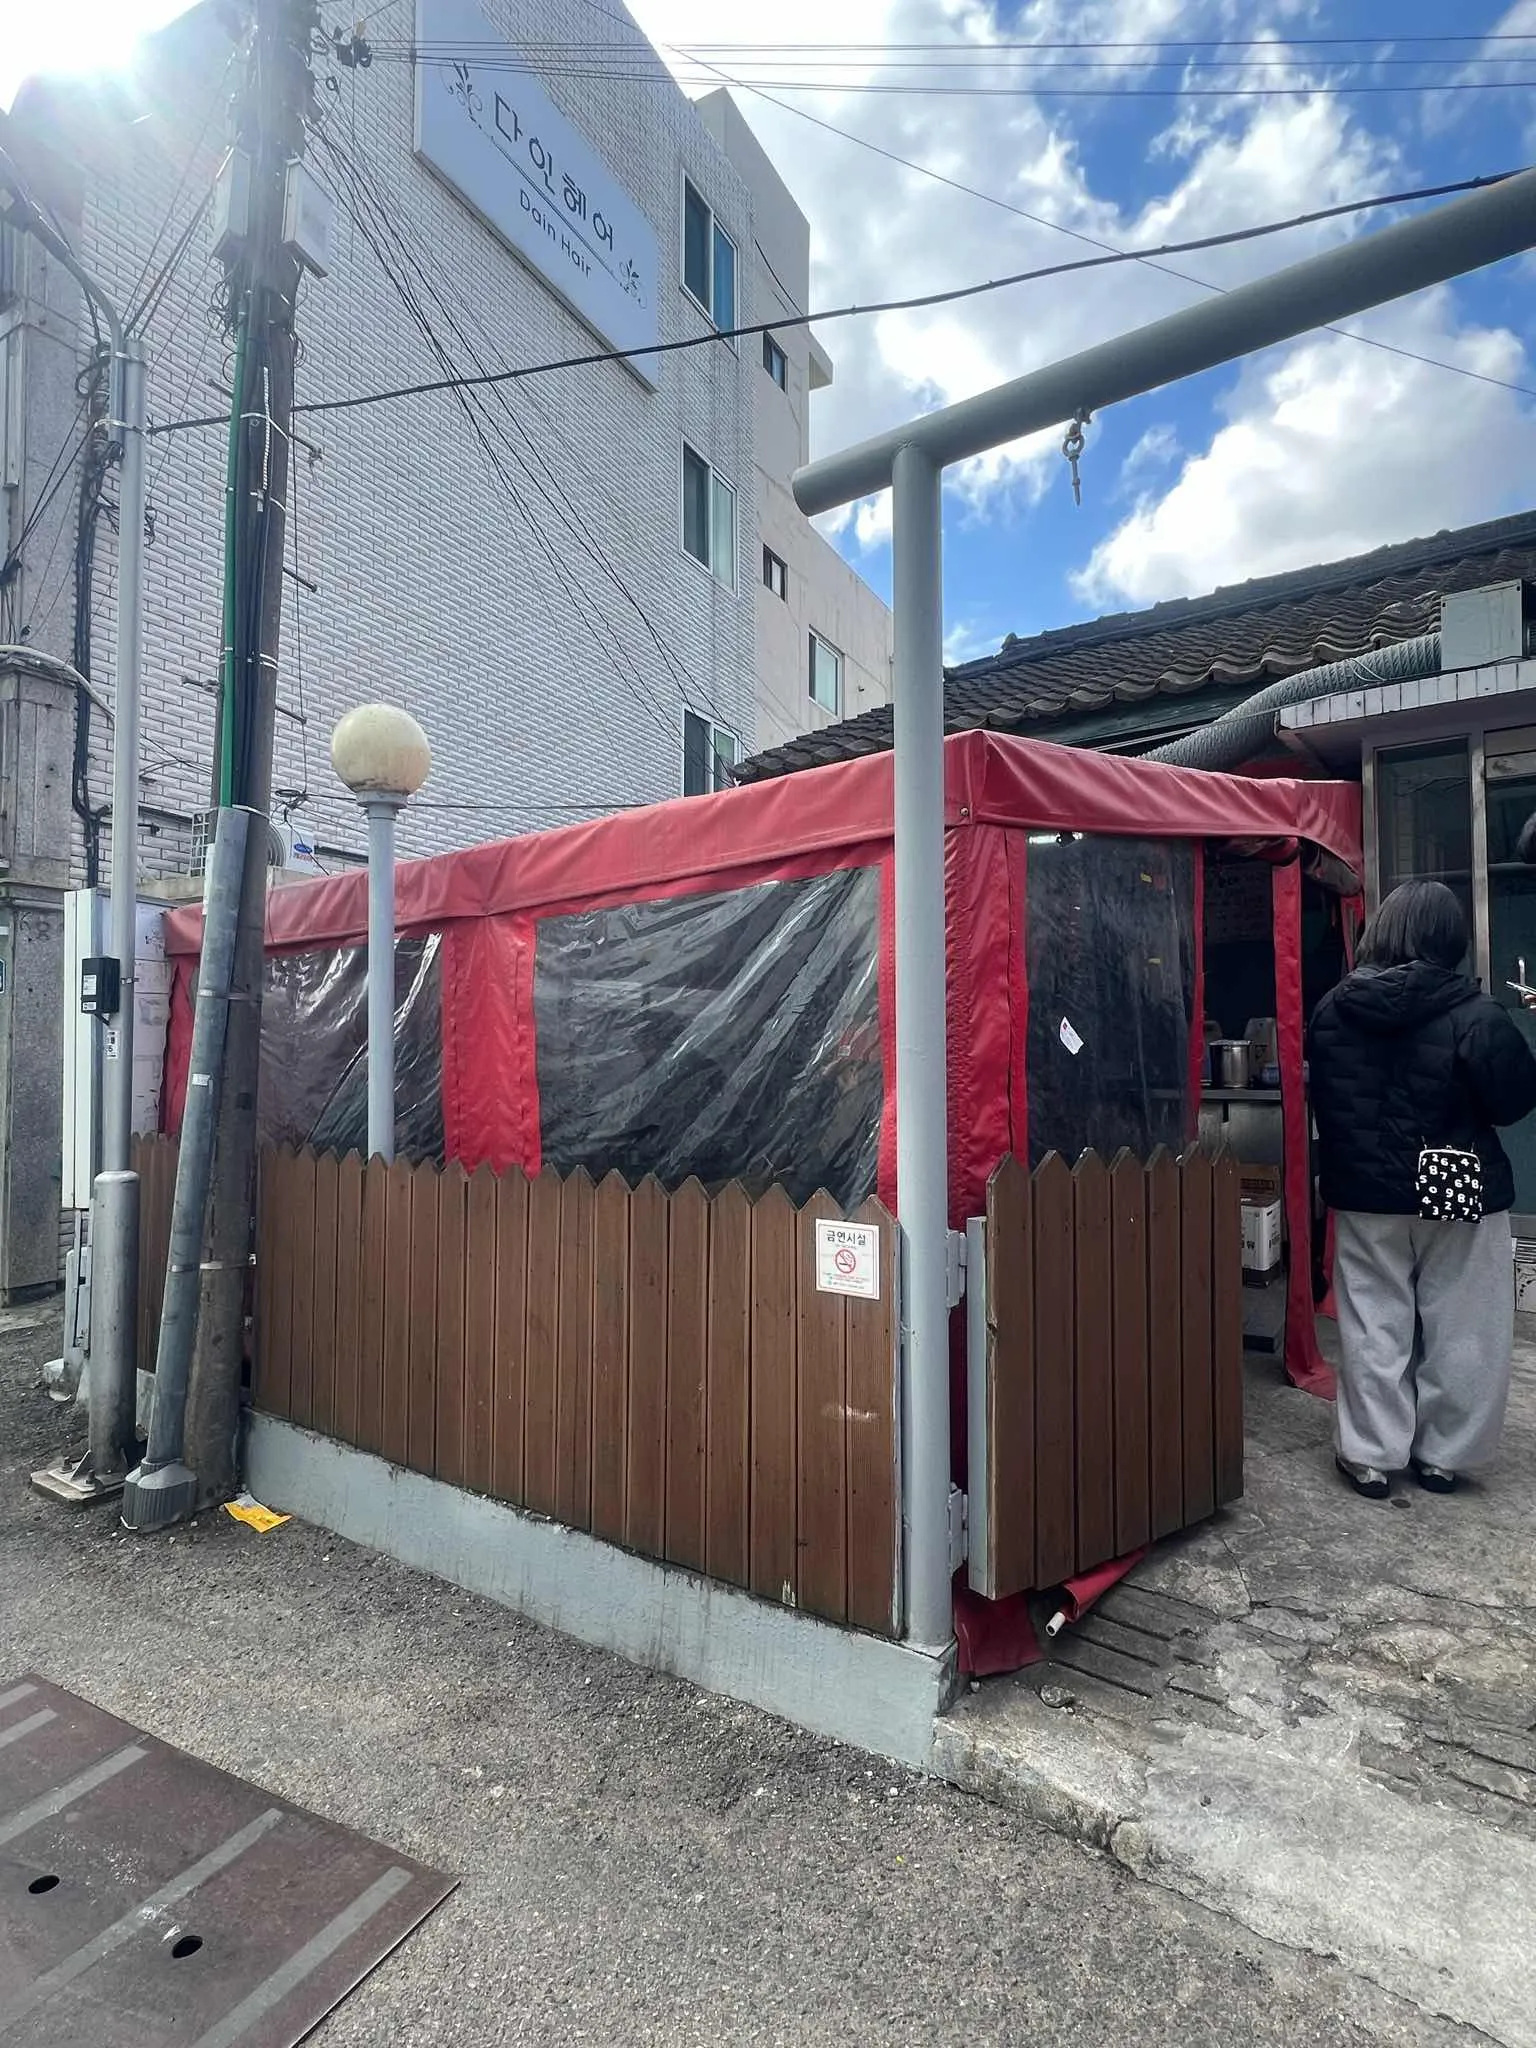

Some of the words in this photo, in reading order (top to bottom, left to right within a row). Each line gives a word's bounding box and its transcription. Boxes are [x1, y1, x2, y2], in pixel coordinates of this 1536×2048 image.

[494, 91, 613, 252] 다인헤어
[520, 188, 556, 241] Dain
[561, 233, 592, 280] Hair
[1428, 1165, 1438, 1175] 8
[1419, 1175, 1427, 1184] 5
[1440, 1171, 1448, 1180] 7
[1463, 1174, 1471, 1183] 3
[1454, 1179, 1463, 1188] 6
[1471, 1179, 1479, 1189] 8
[1445, 1188, 1454, 1198] 9
[1421, 1196, 1432, 1204] 4
[1457, 1193, 1466, 1203] 8
[1444, 1201, 1452, 1210] 2
[1432, 1206, 1439, 1215] 3
[1462, 1207, 1470, 1216] 7
[826, 1230, 866, 1246] 금연시설
